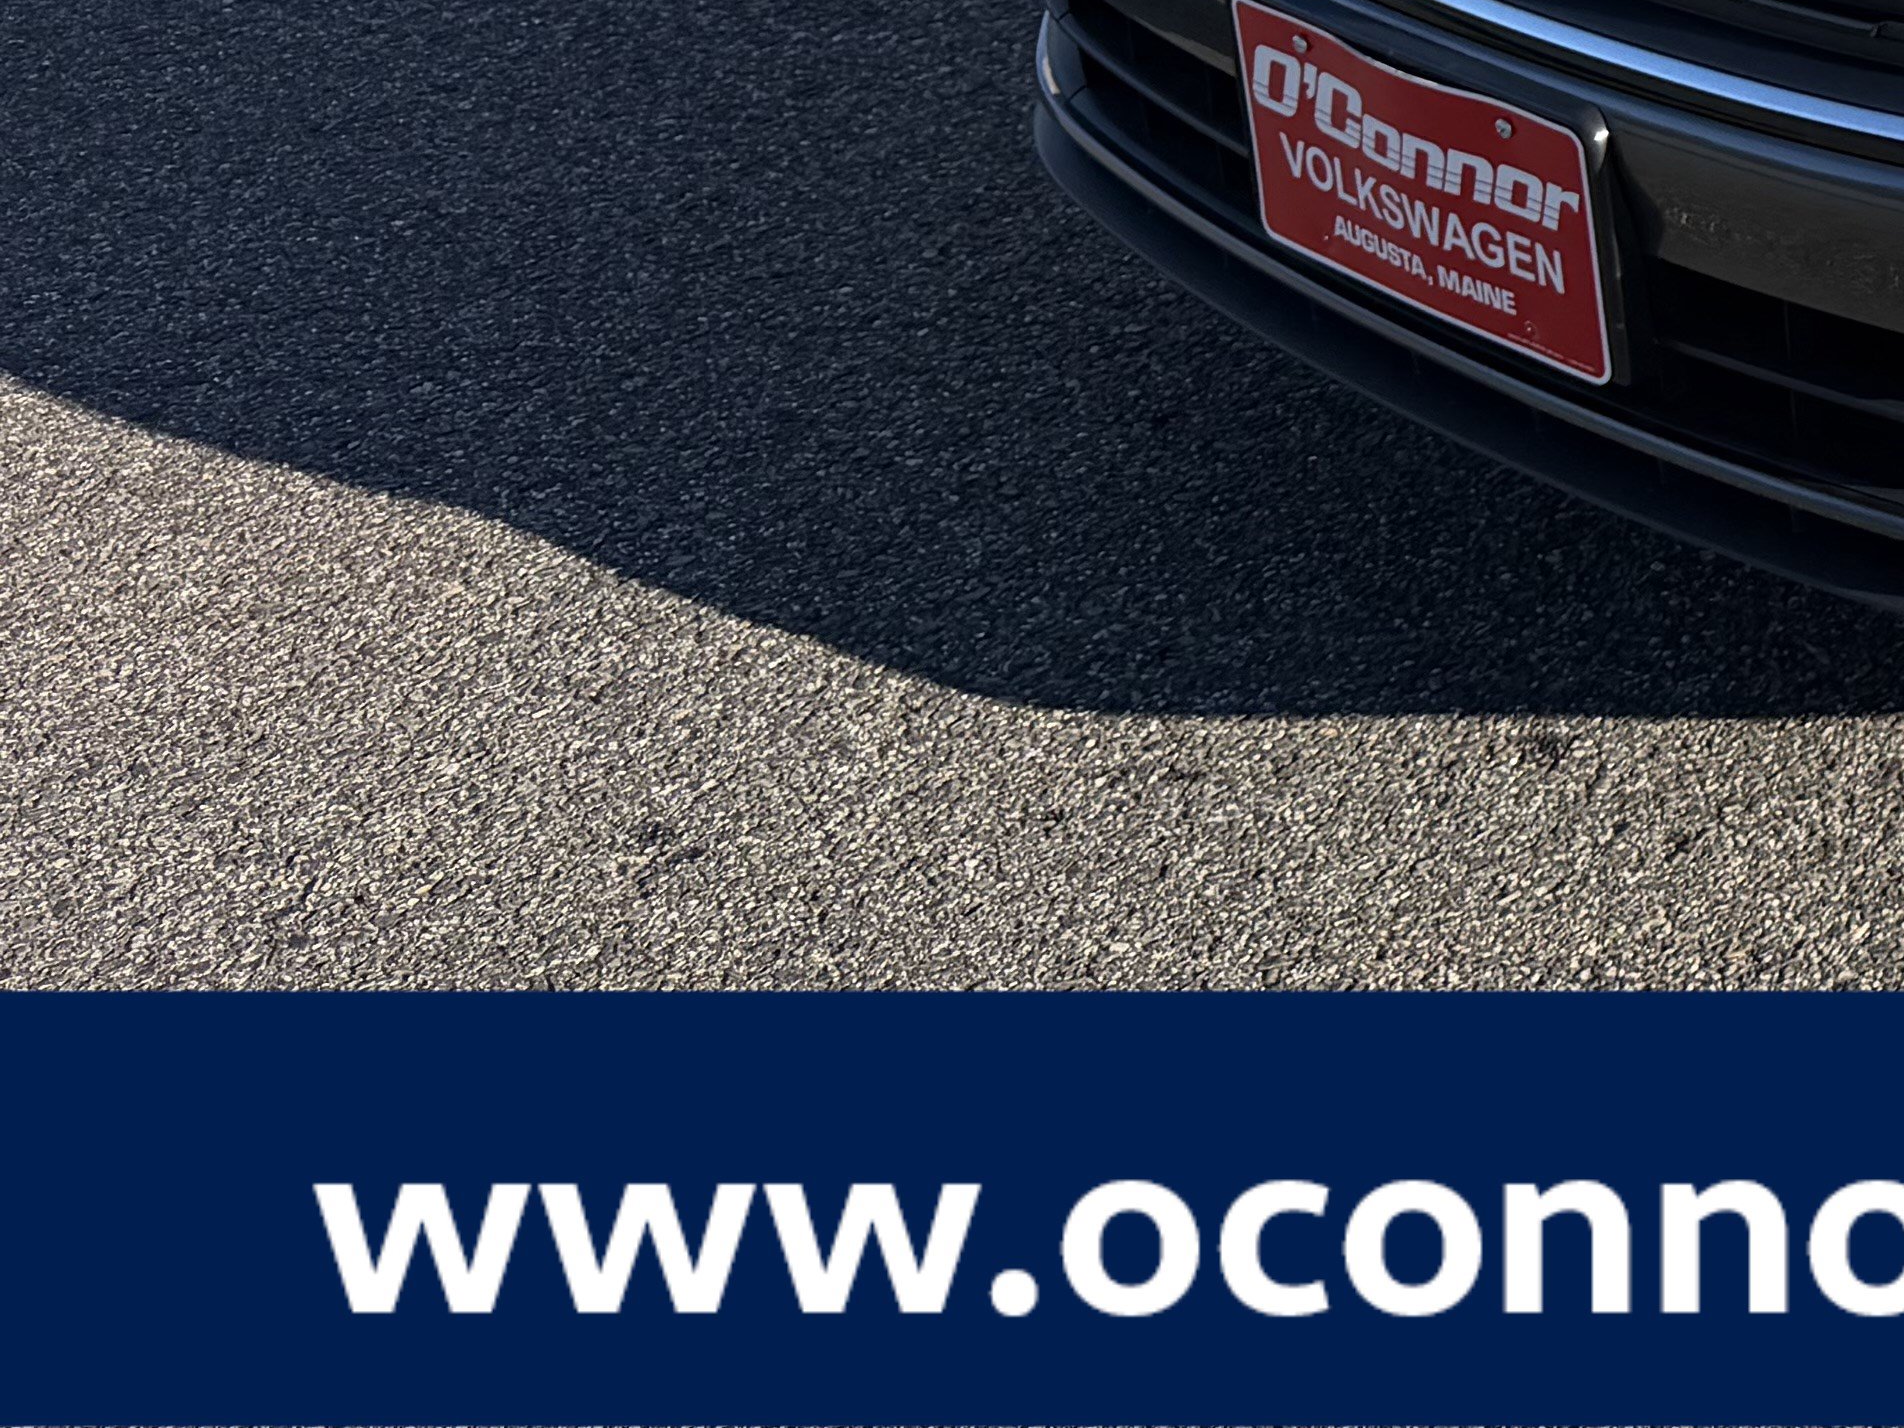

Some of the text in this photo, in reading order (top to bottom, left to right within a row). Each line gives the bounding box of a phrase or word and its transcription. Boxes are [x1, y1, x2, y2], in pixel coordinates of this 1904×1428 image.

[1252, 43, 1580, 231] O'Connor
[1279, 131, 1566, 294] VOLKSWAGEN
[1333, 215, 1518, 316] AUGUSTA, MAINE
